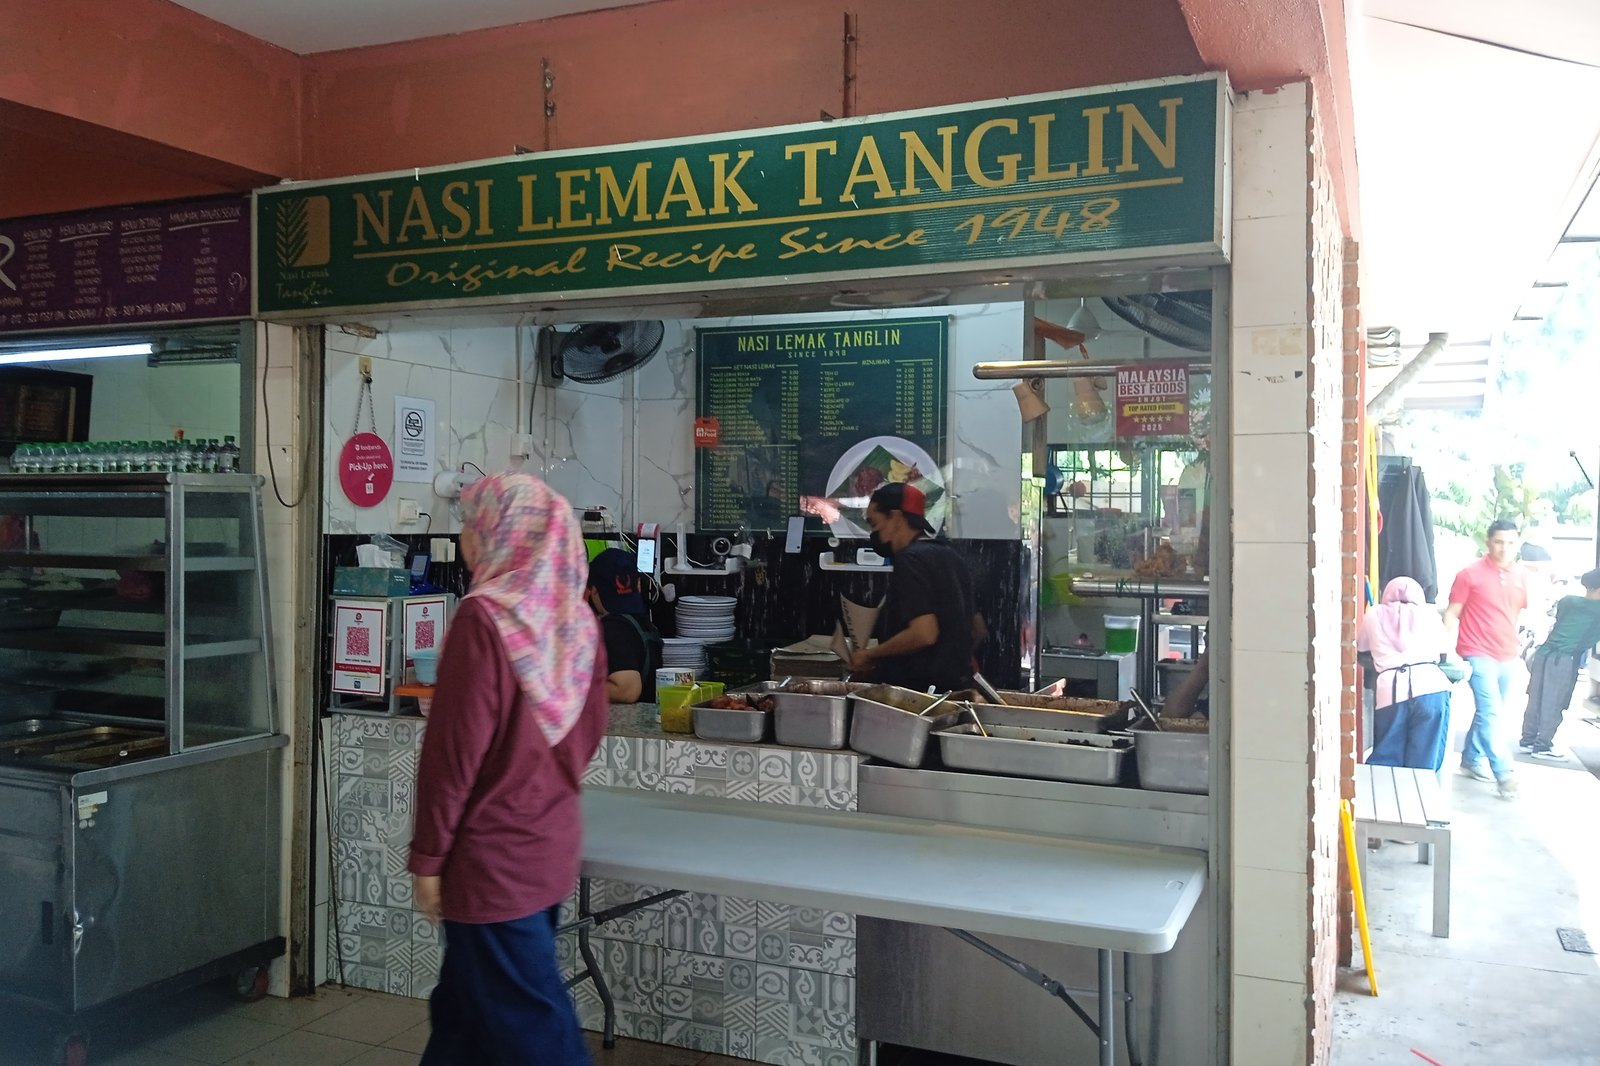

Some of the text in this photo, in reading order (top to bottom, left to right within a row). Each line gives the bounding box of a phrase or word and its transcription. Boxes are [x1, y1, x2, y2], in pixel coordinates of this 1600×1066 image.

[352, 97, 1183, 247] NASI LEMAK TANGLIN
[387, 198, 1120, 292] Original Recipe Since 1948
[738, 329, 900, 352] NASI LEMAK TANGLIN
[788, 351, 816, 359] SINCE
[1118, 368, 1186, 383] MALAYSIA
[1120, 381, 1184, 395] BEST FOODS
[1141, 424, 1163, 432] 2025
[349, 463, 372, 472] Pick-Up
[373, 461, 389, 470] here.
